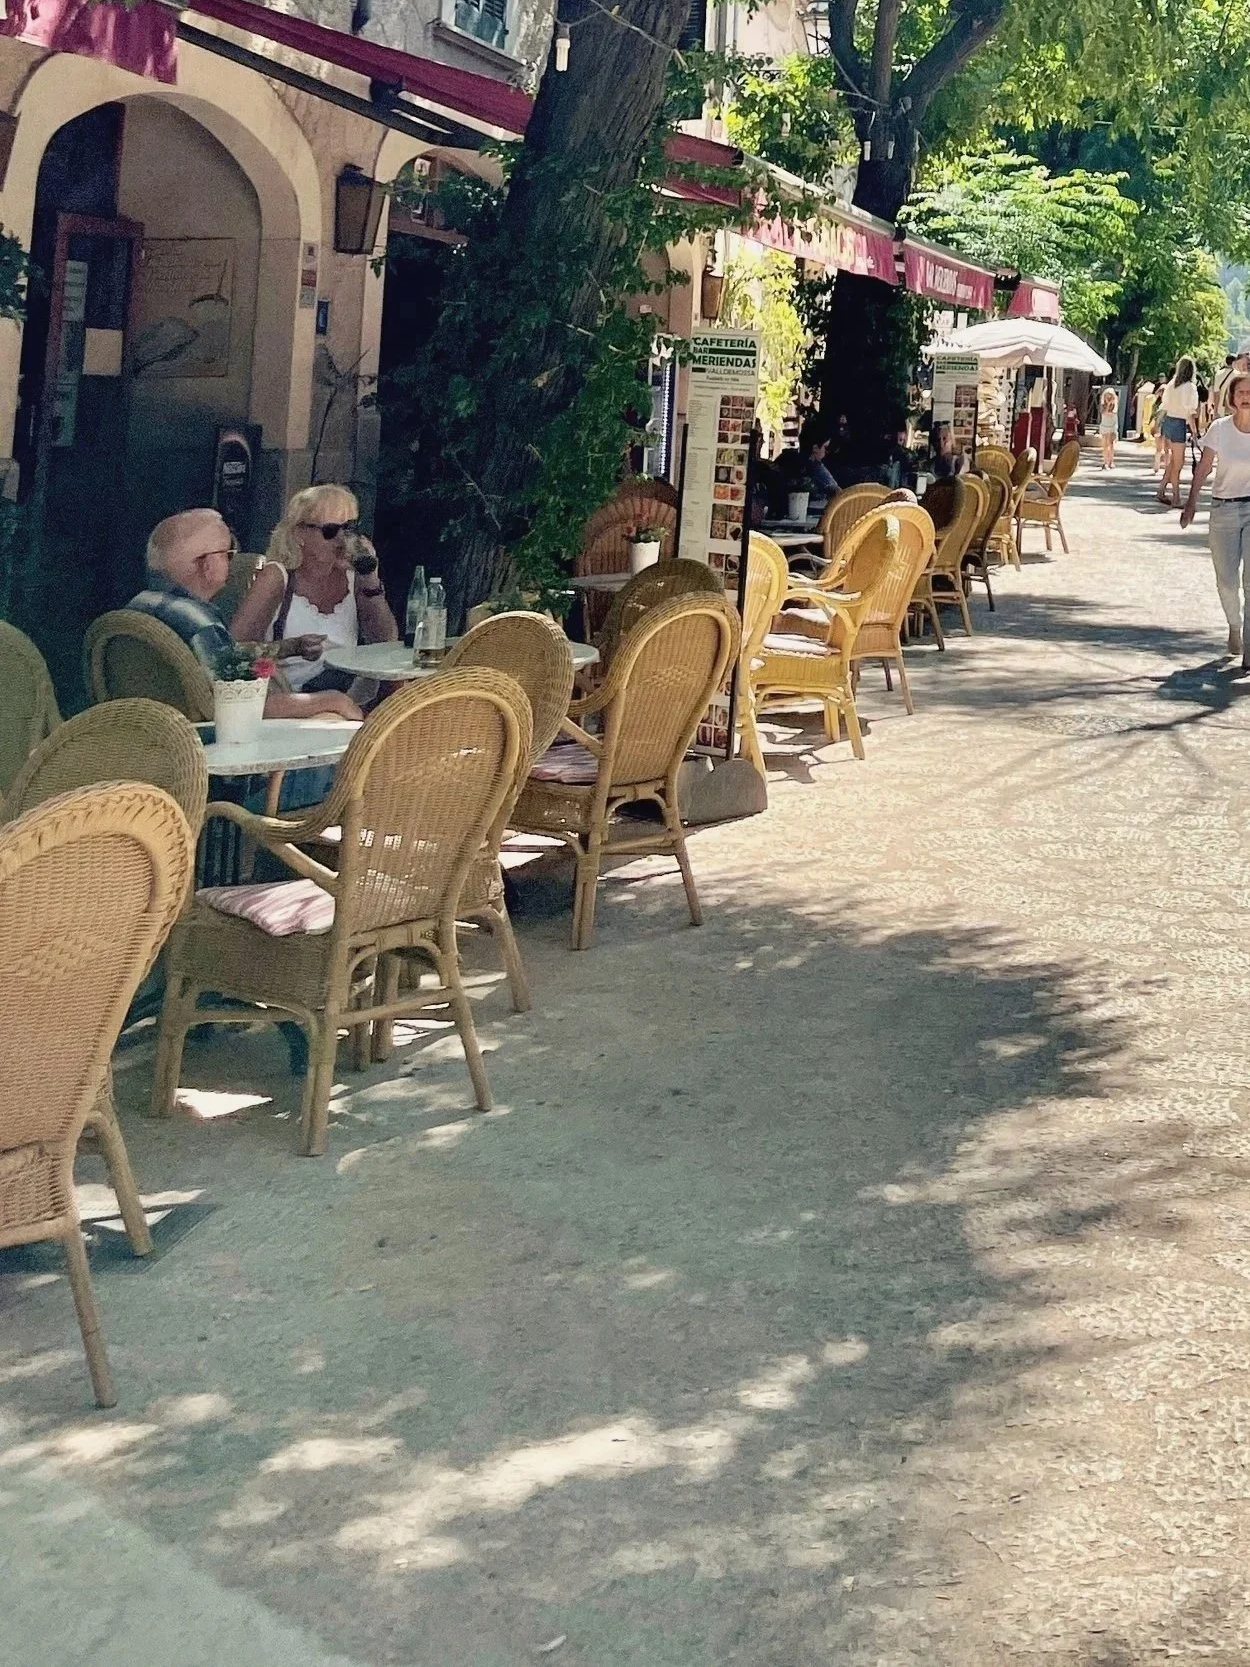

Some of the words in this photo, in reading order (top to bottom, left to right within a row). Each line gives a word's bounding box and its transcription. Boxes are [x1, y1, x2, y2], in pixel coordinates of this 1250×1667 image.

[693, 337, 757, 349] CAFETERÍA
[693, 346, 708, 354] BAR
[692, 355, 757, 368] MERIENDAS
